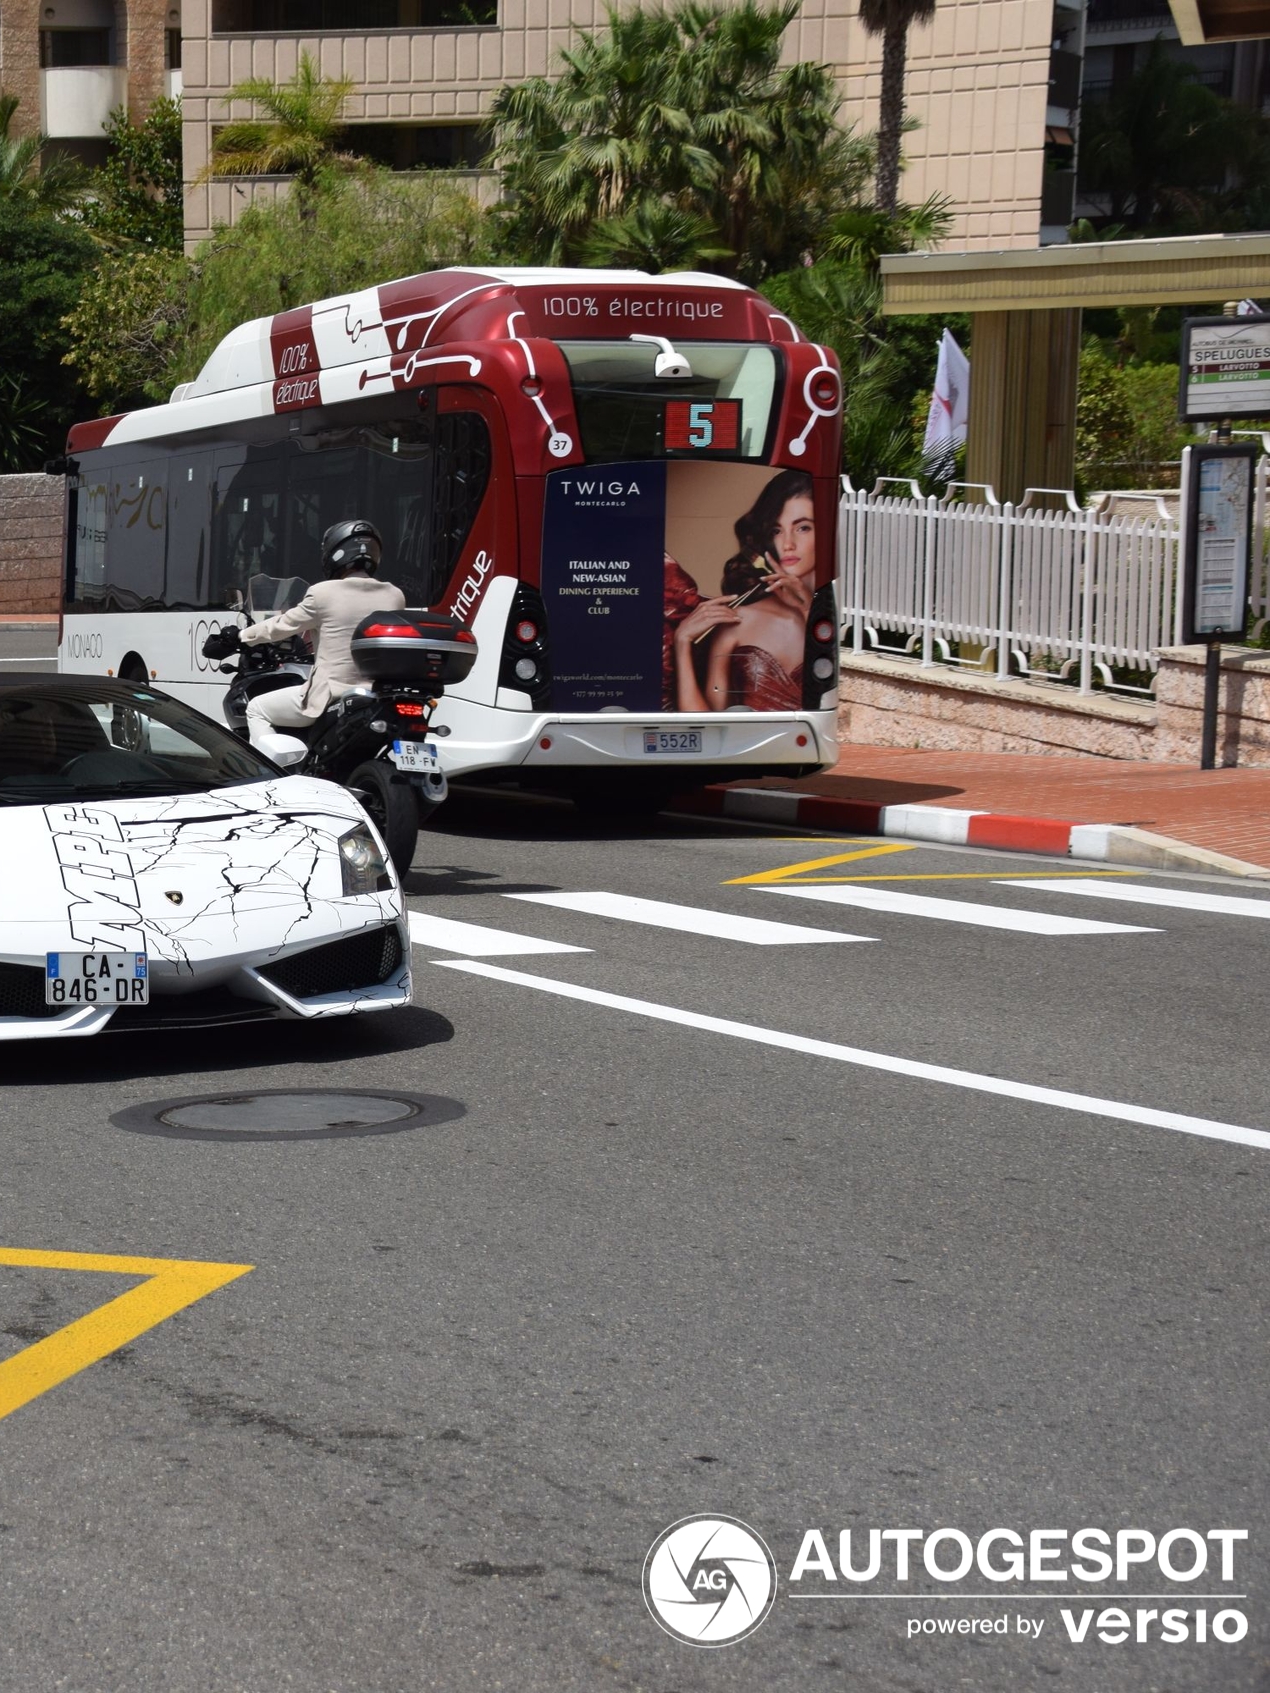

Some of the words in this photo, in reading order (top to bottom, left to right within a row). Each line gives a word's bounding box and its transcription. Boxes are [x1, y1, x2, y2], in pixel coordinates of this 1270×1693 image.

[543, 297, 599, 316] 100%
[609, 298, 724, 321] électrique
[279, 343, 309, 374] 100%
[1195, 347, 1270, 362] SPELUGUES
[1219, 363, 1260, 371] LARVOTTO
[1218, 372, 1259, 381] LARVOTTO
[689, 403, 714, 448] 5
[553, 440, 568, 451] 37
[560, 481, 641, 495] TWIGA
[569, 561, 606, 570] ITALIAN
[607, 561, 630, 570] AND
[572, 574, 627, 583] NEW-ASIAN
[450, 550, 493, 623] trique
[559, 587, 591, 596] DINING
[592, 587, 640, 596] EXPERIENCE
[595, 597, 602, 605] &
[587, 607, 610, 615] CLUB
[67, 633, 103, 659] MONACO
[660, 734, 698, 748] 552R
[136, 967, 146, 976] 75
[52, 978, 145, 1002] 846-DR
